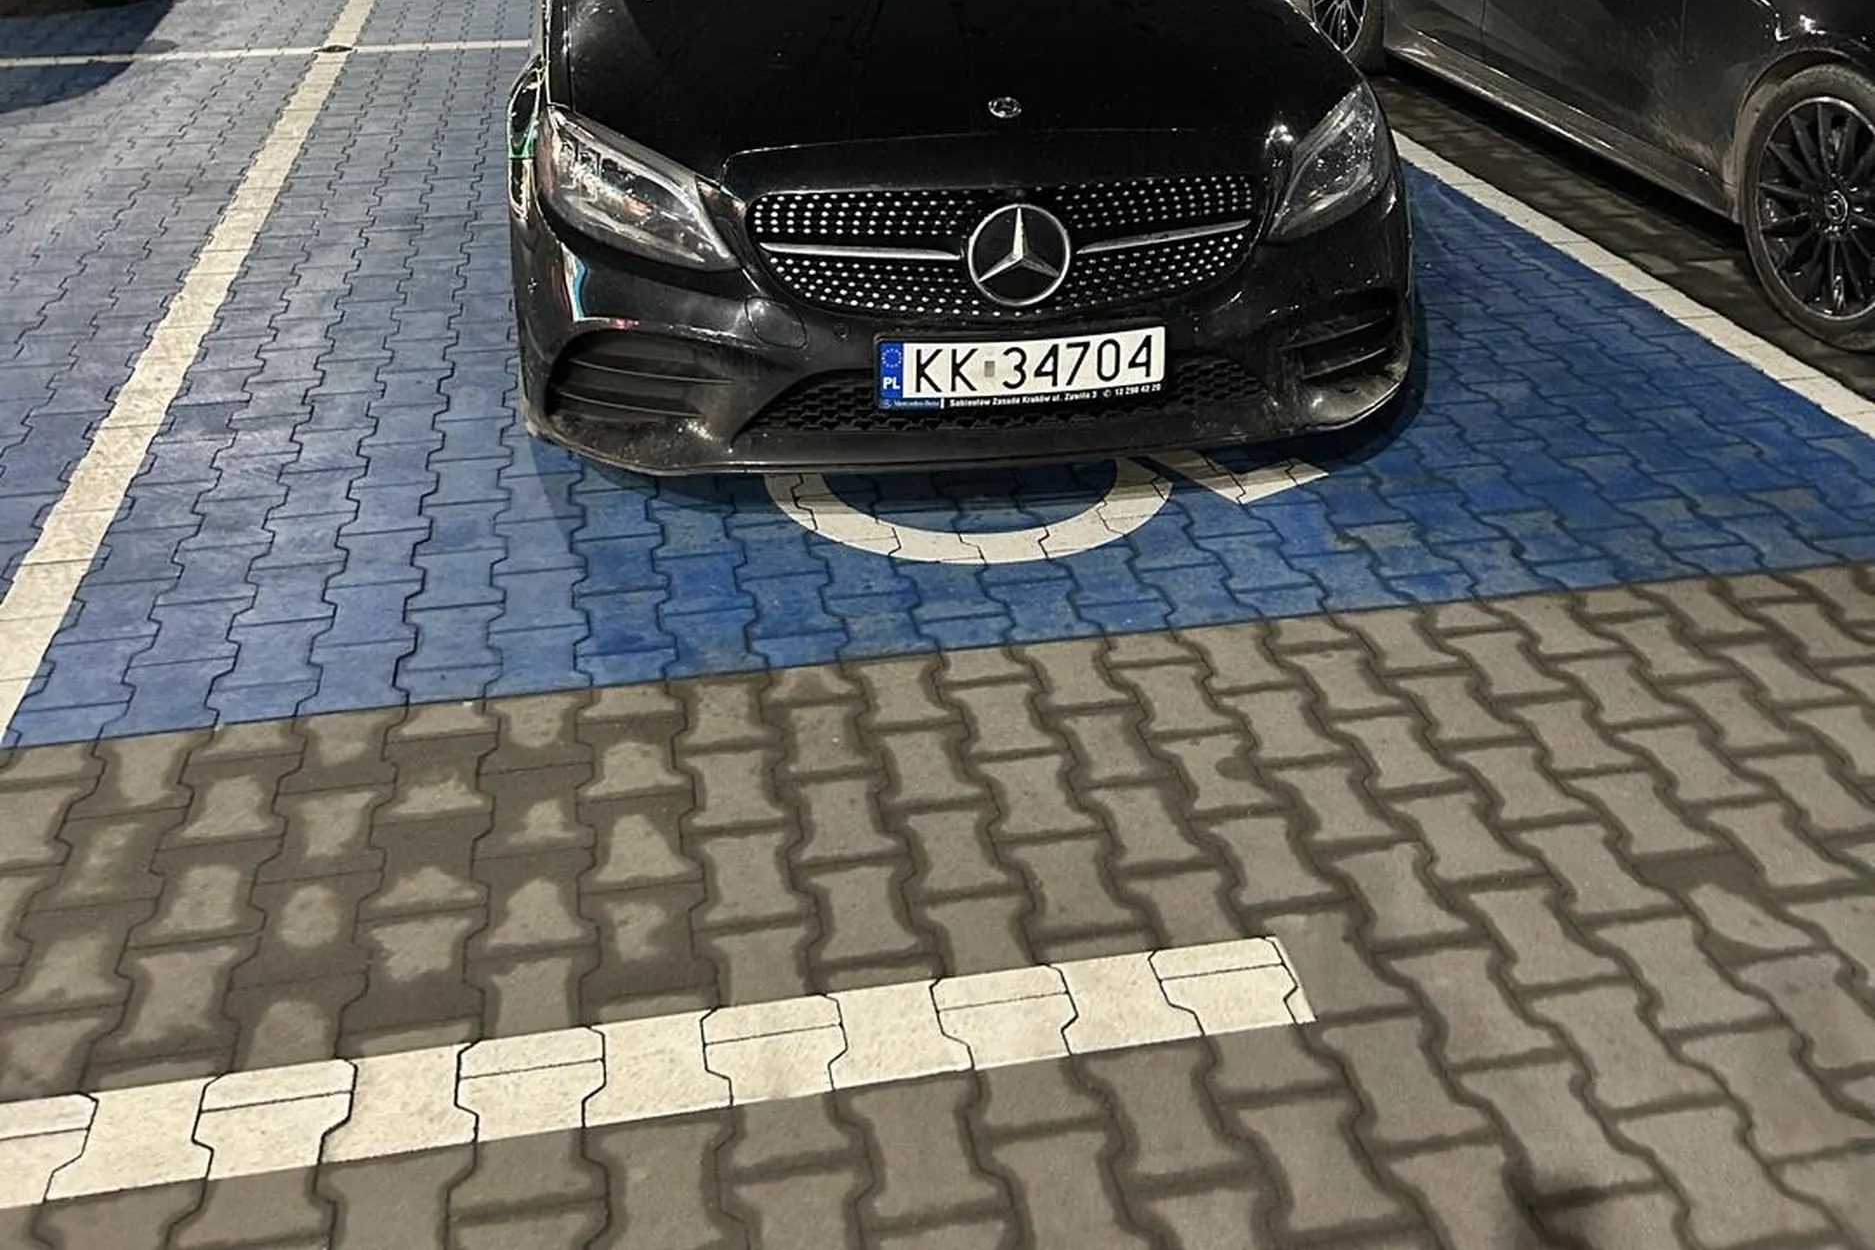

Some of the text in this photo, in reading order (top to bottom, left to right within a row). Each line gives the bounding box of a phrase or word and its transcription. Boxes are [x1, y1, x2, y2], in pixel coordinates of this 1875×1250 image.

[915, 334, 1153, 393] KK 34704
[882, 377, 900, 390] PL
[992, 396, 1020, 406] Zasada
